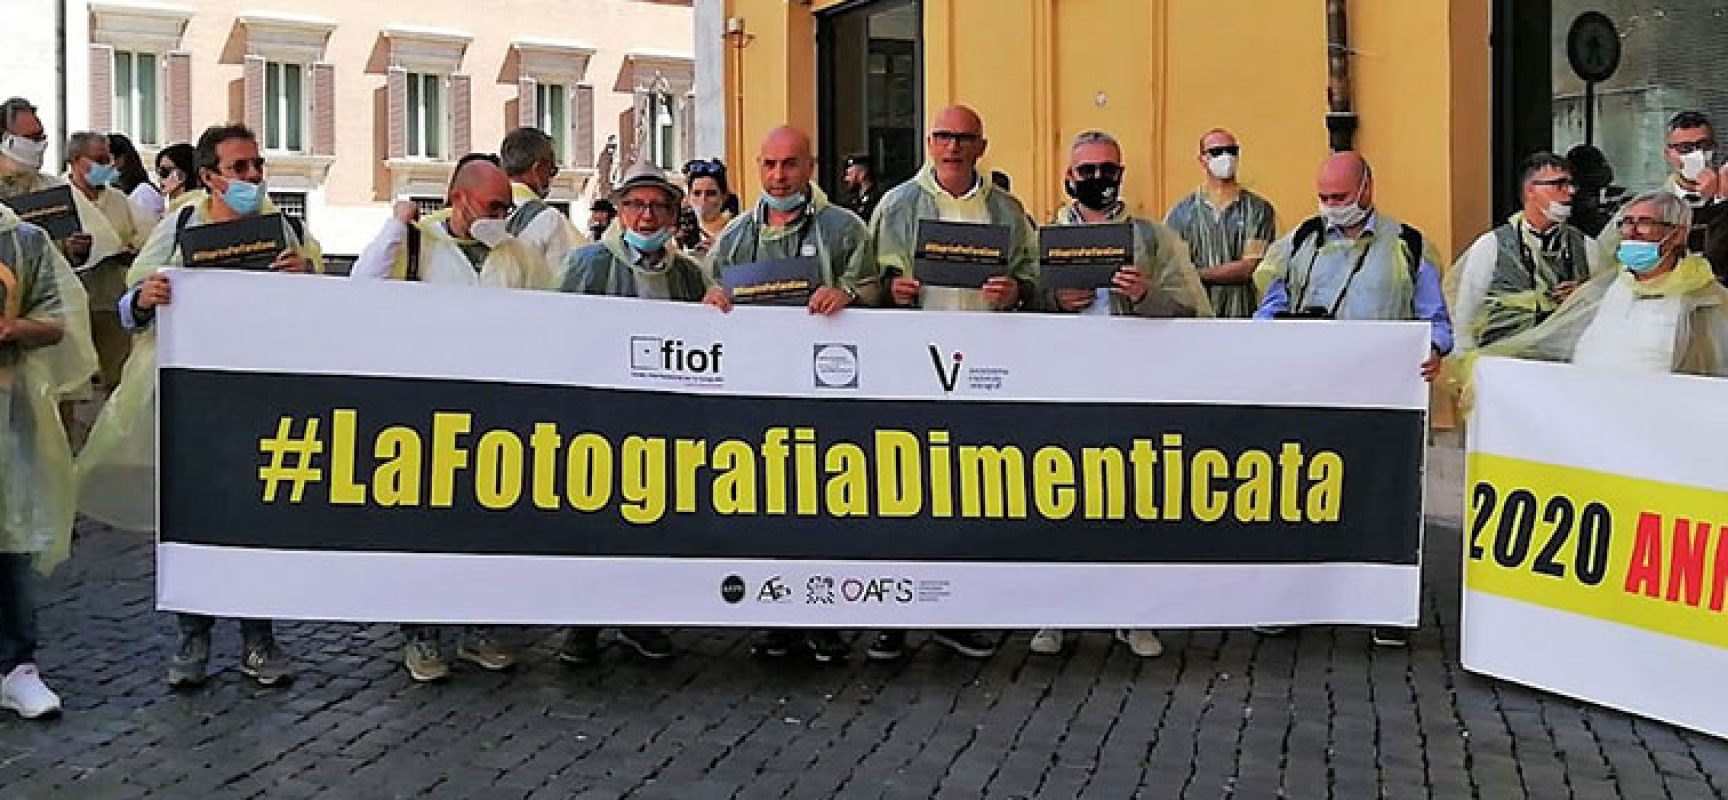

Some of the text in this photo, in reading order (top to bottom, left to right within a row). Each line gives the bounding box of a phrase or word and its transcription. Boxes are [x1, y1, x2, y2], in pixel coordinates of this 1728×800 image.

[661, 340, 723, 373] fiof
[259, 408, 1344, 524] #LaFotografiaDimenticata
[1468, 481, 1611, 586] 2020
